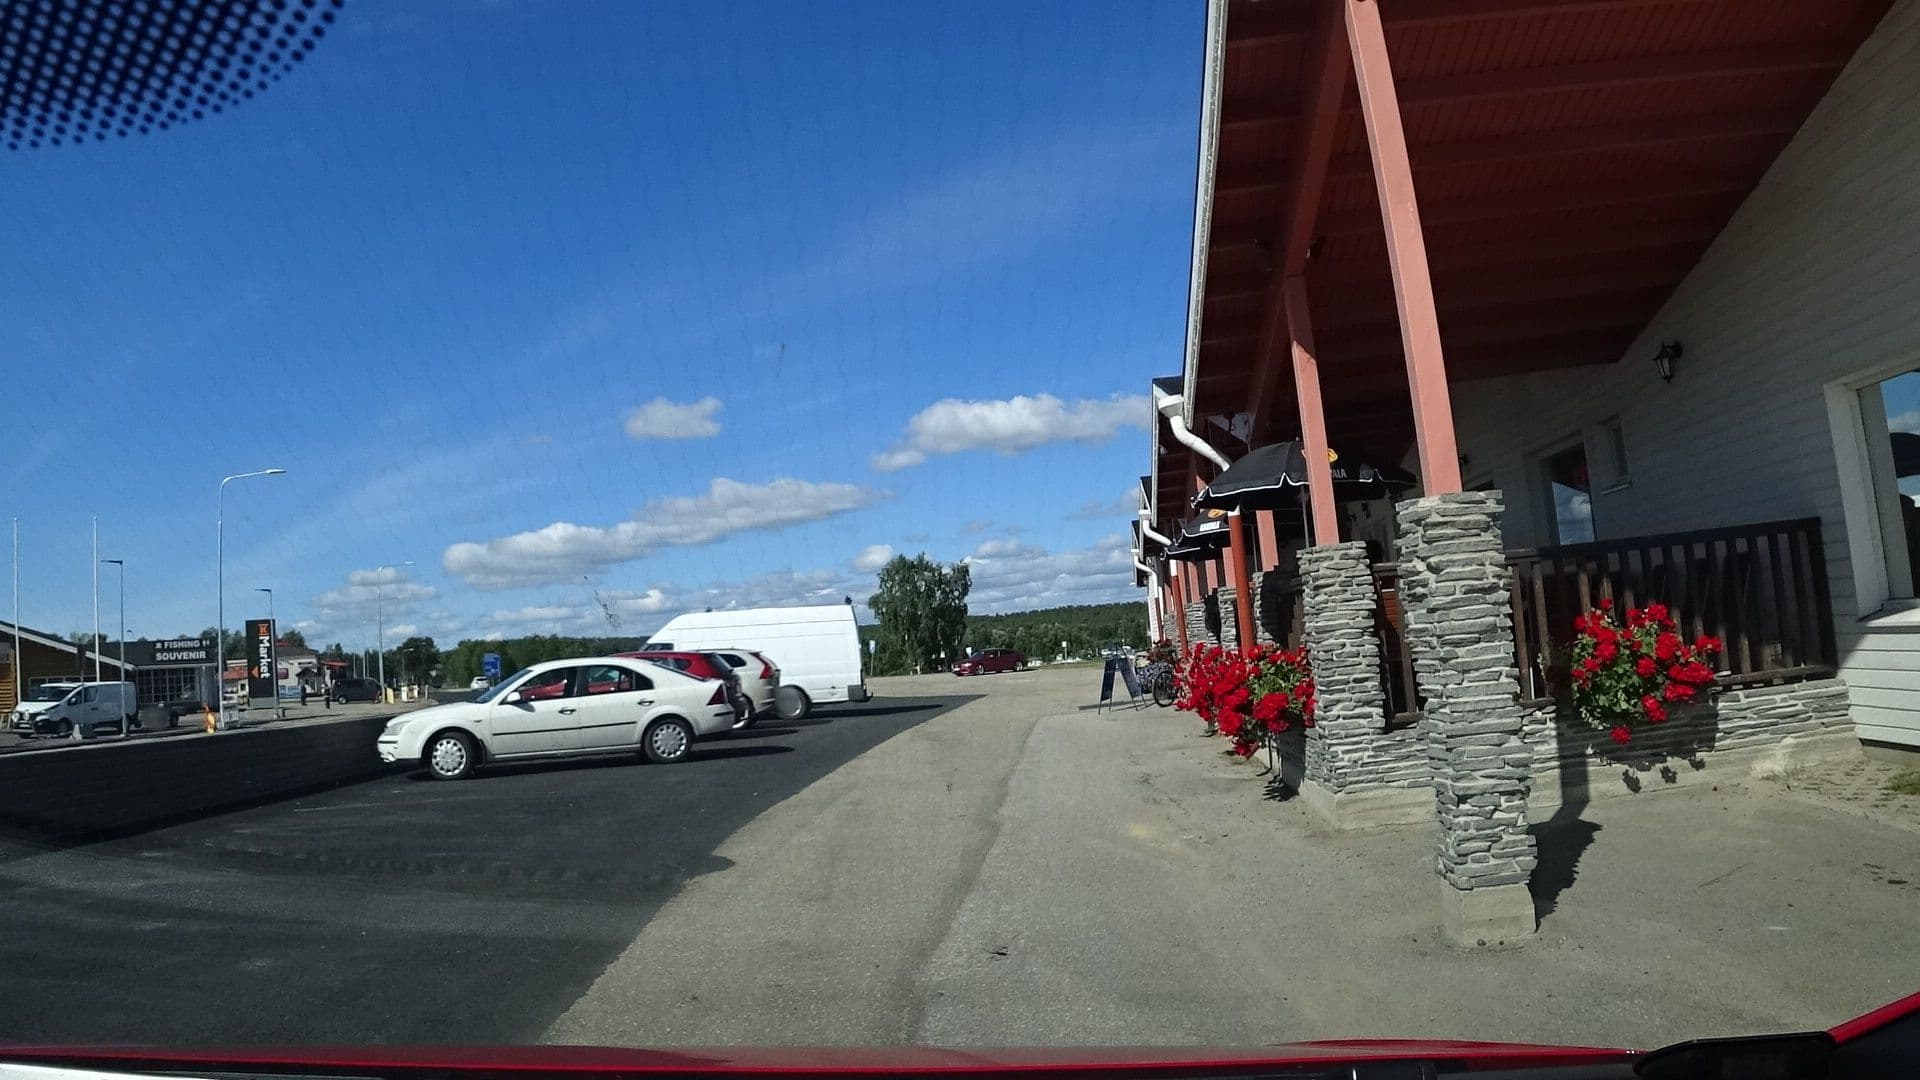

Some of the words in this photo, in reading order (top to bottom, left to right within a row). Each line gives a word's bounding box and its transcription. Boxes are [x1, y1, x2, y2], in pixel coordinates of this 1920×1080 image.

[164, 639, 200, 649] FISHING
[155, 650, 206, 661] SOUVENIR
[259, 636, 272, 678] Market
